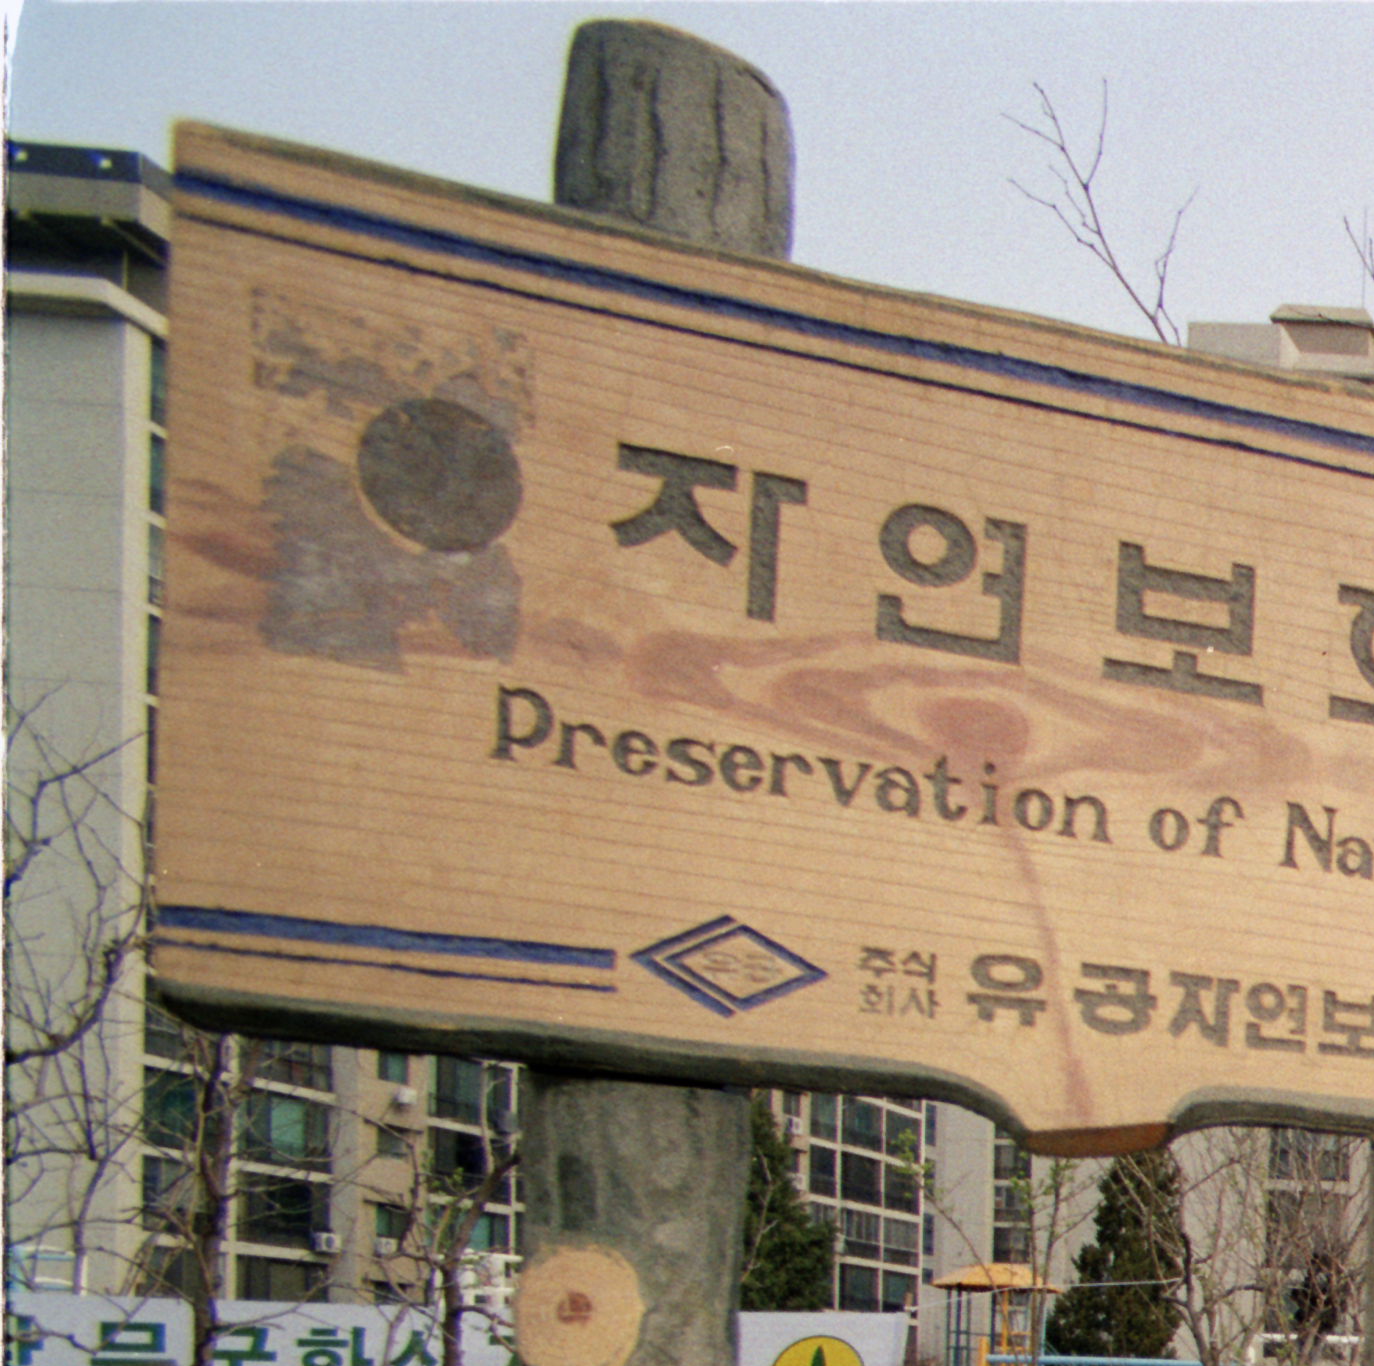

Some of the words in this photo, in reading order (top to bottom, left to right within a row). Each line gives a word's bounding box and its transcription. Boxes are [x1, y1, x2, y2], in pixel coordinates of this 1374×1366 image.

[491, 684, 1112, 843] Preservation
[1149, 796, 1243, 858] of
[857, 946, 938, 985] 주식
[858, 982, 941, 1019] 회사
